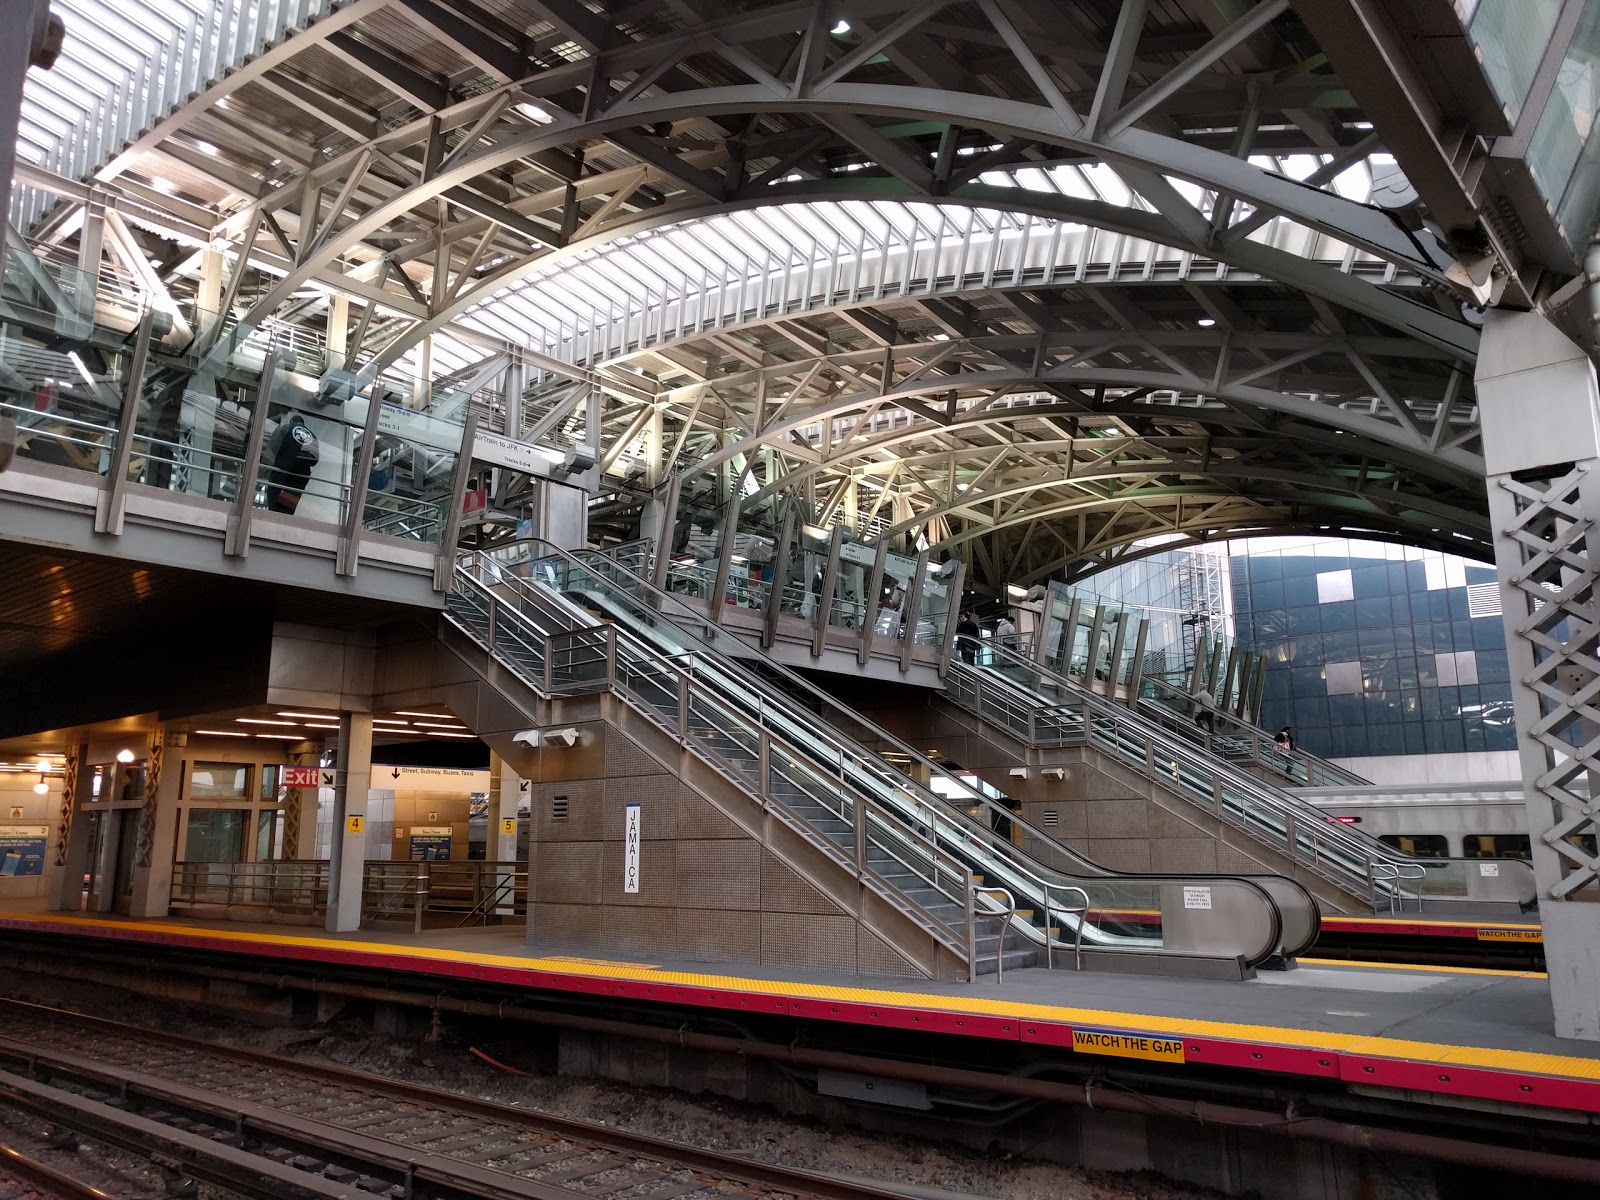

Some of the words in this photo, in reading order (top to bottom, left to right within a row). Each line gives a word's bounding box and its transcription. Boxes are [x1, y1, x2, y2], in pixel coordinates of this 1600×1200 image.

[474, 433, 498, 446] AirTrain
[499, 440, 506, 448] to
[506, 443, 519, 452] JFK
[282, 768, 318, 785] Exit
[401, 767, 420, 775] Street,
[352, 817, 360, 829] 4
[505, 820, 512, 831] 5
[628, 810, 637, 889] JAMAICA
[1478, 930, 1506, 938] WATCH
[1074, 1032, 1120, 1048] WATCH
[1122, 1037, 1149, 1051] THE
[1152, 1040, 1183, 1054] GAP
